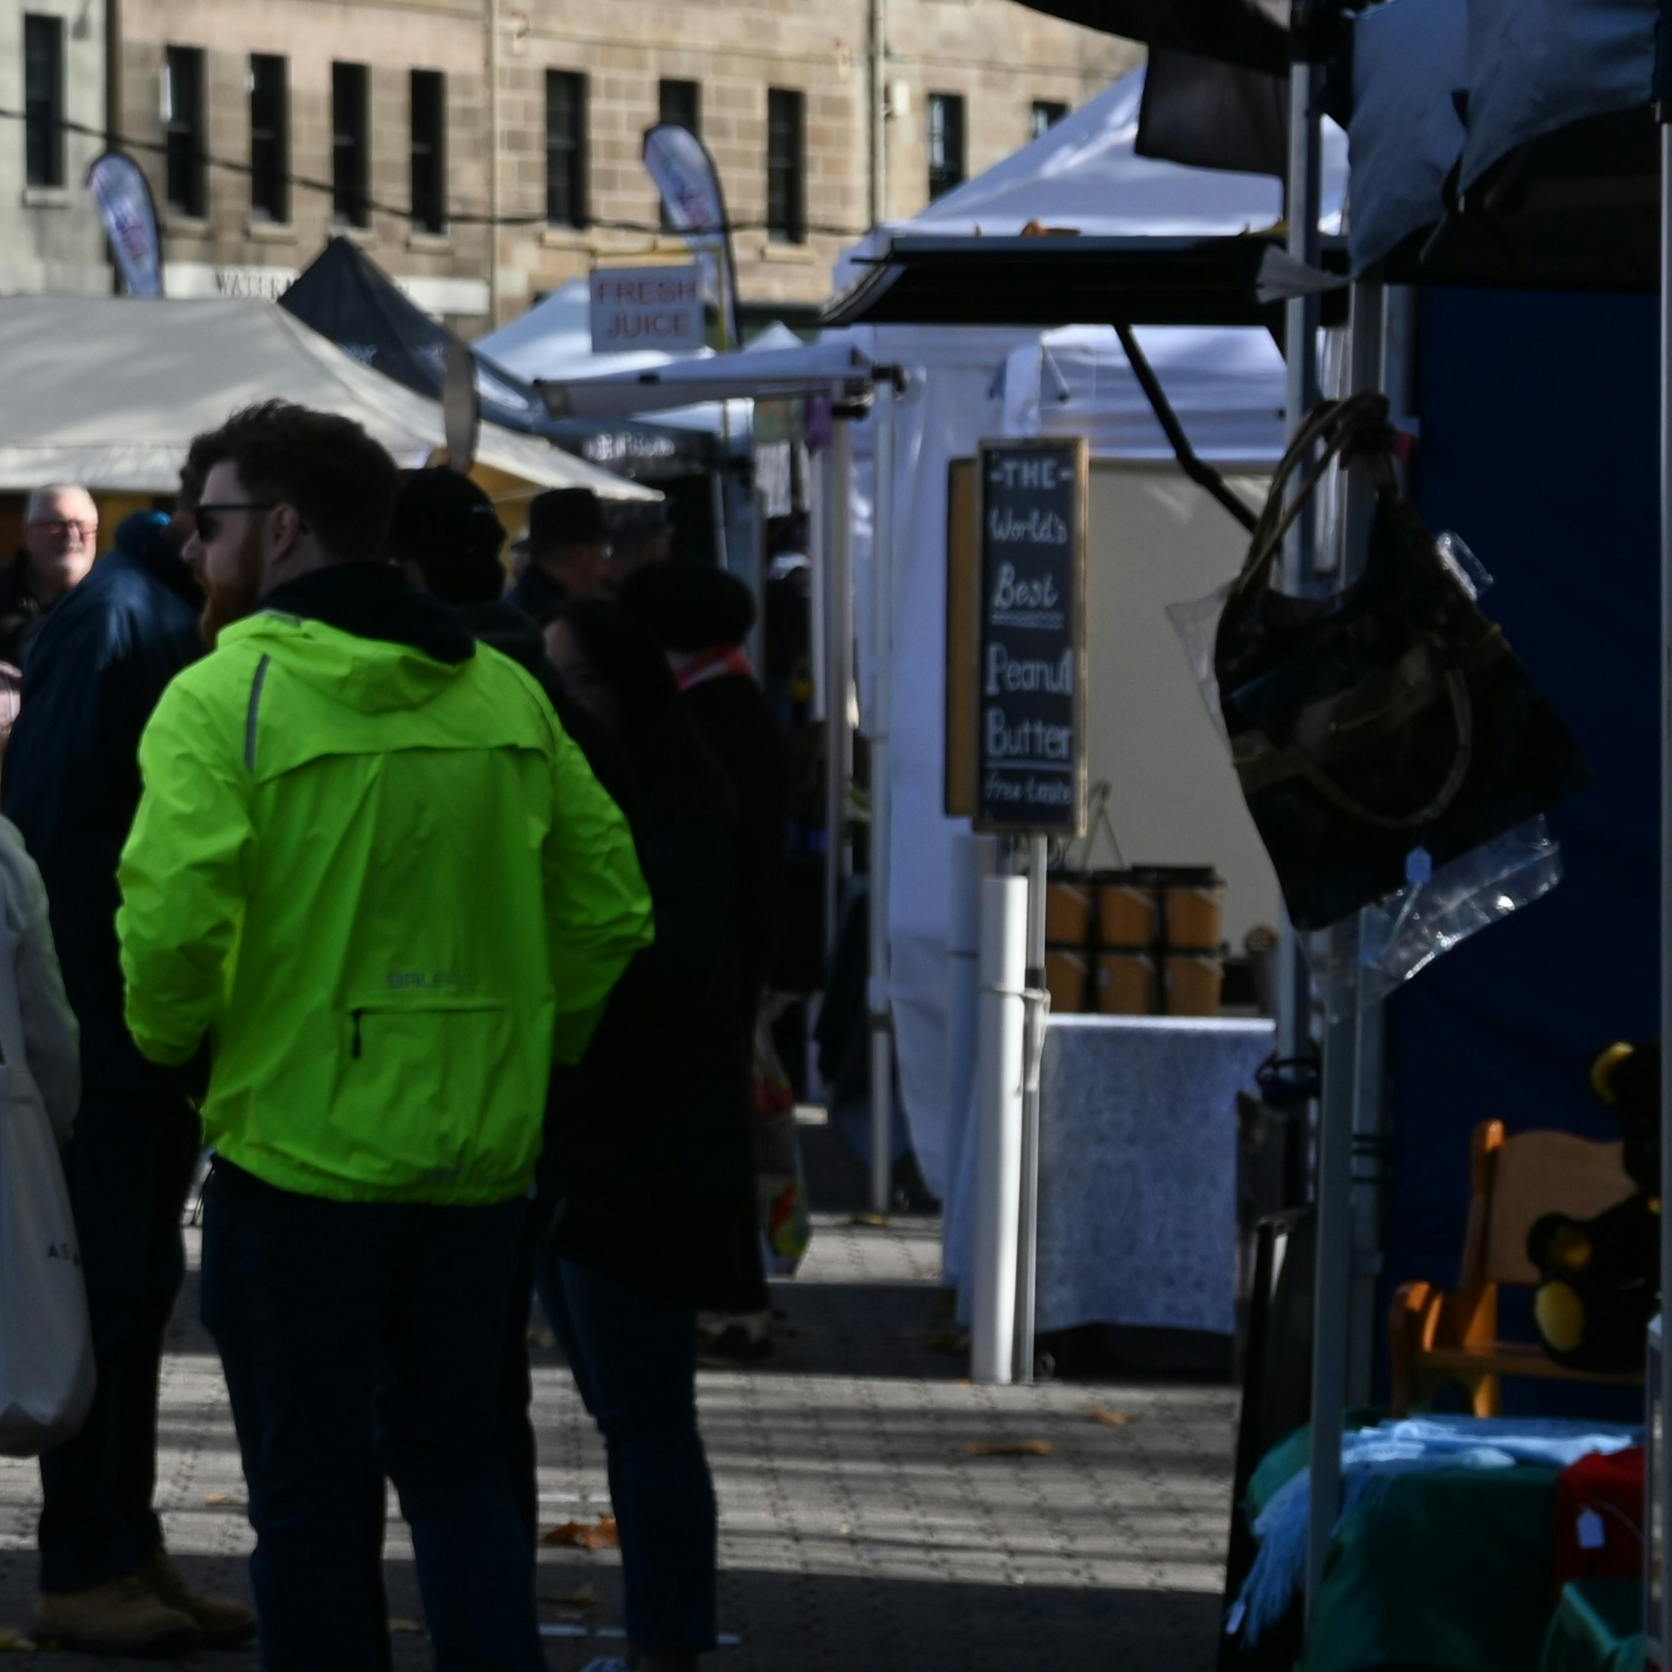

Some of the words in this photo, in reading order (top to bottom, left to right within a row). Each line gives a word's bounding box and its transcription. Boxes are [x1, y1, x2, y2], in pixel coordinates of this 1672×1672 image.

[596, 279, 697, 304] FRESH
[610, 312, 689, 338] JUICE
[993, 560, 1058, 609] Best
[986, 707, 1072, 760] Butter
